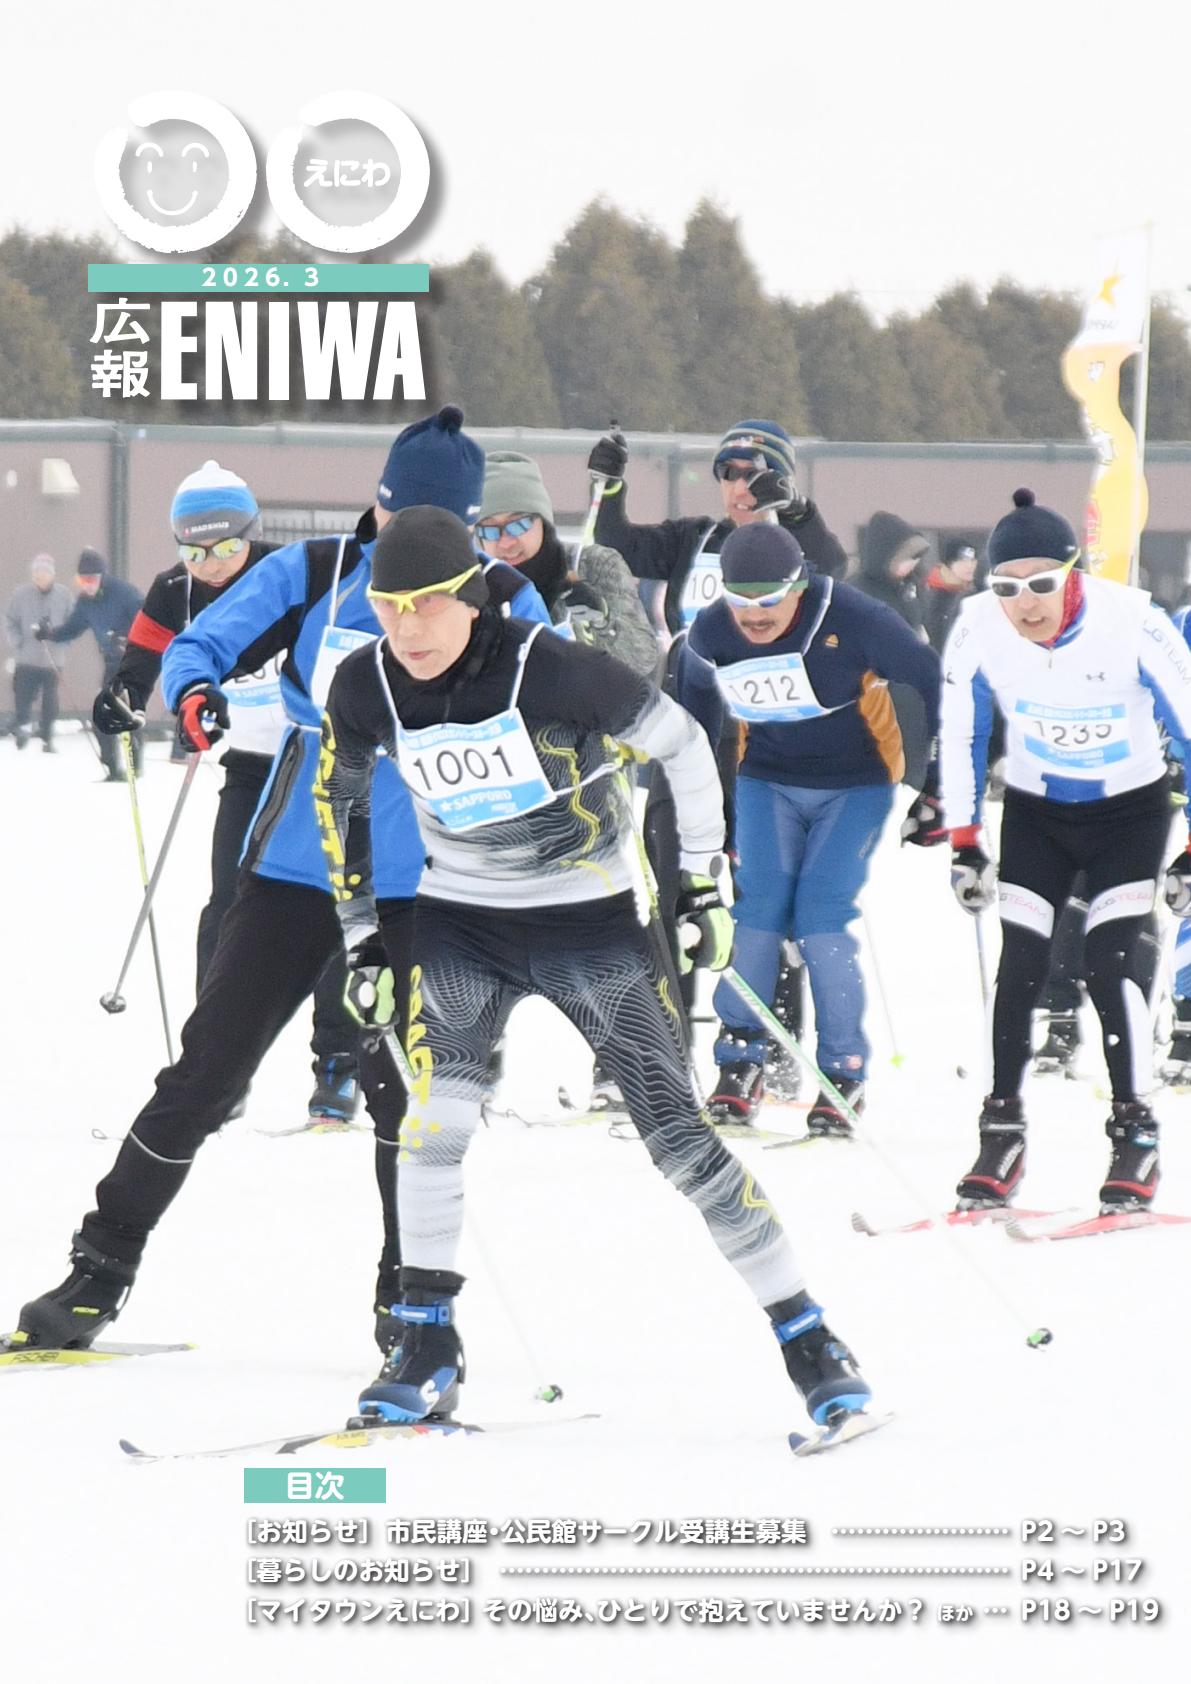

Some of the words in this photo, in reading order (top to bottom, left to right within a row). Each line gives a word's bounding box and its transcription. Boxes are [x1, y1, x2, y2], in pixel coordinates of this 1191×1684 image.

[728, 675, 801, 704] 1212
[413, 746, 513, 791] 1001
[453, 789, 513, 810] SAPPORO
